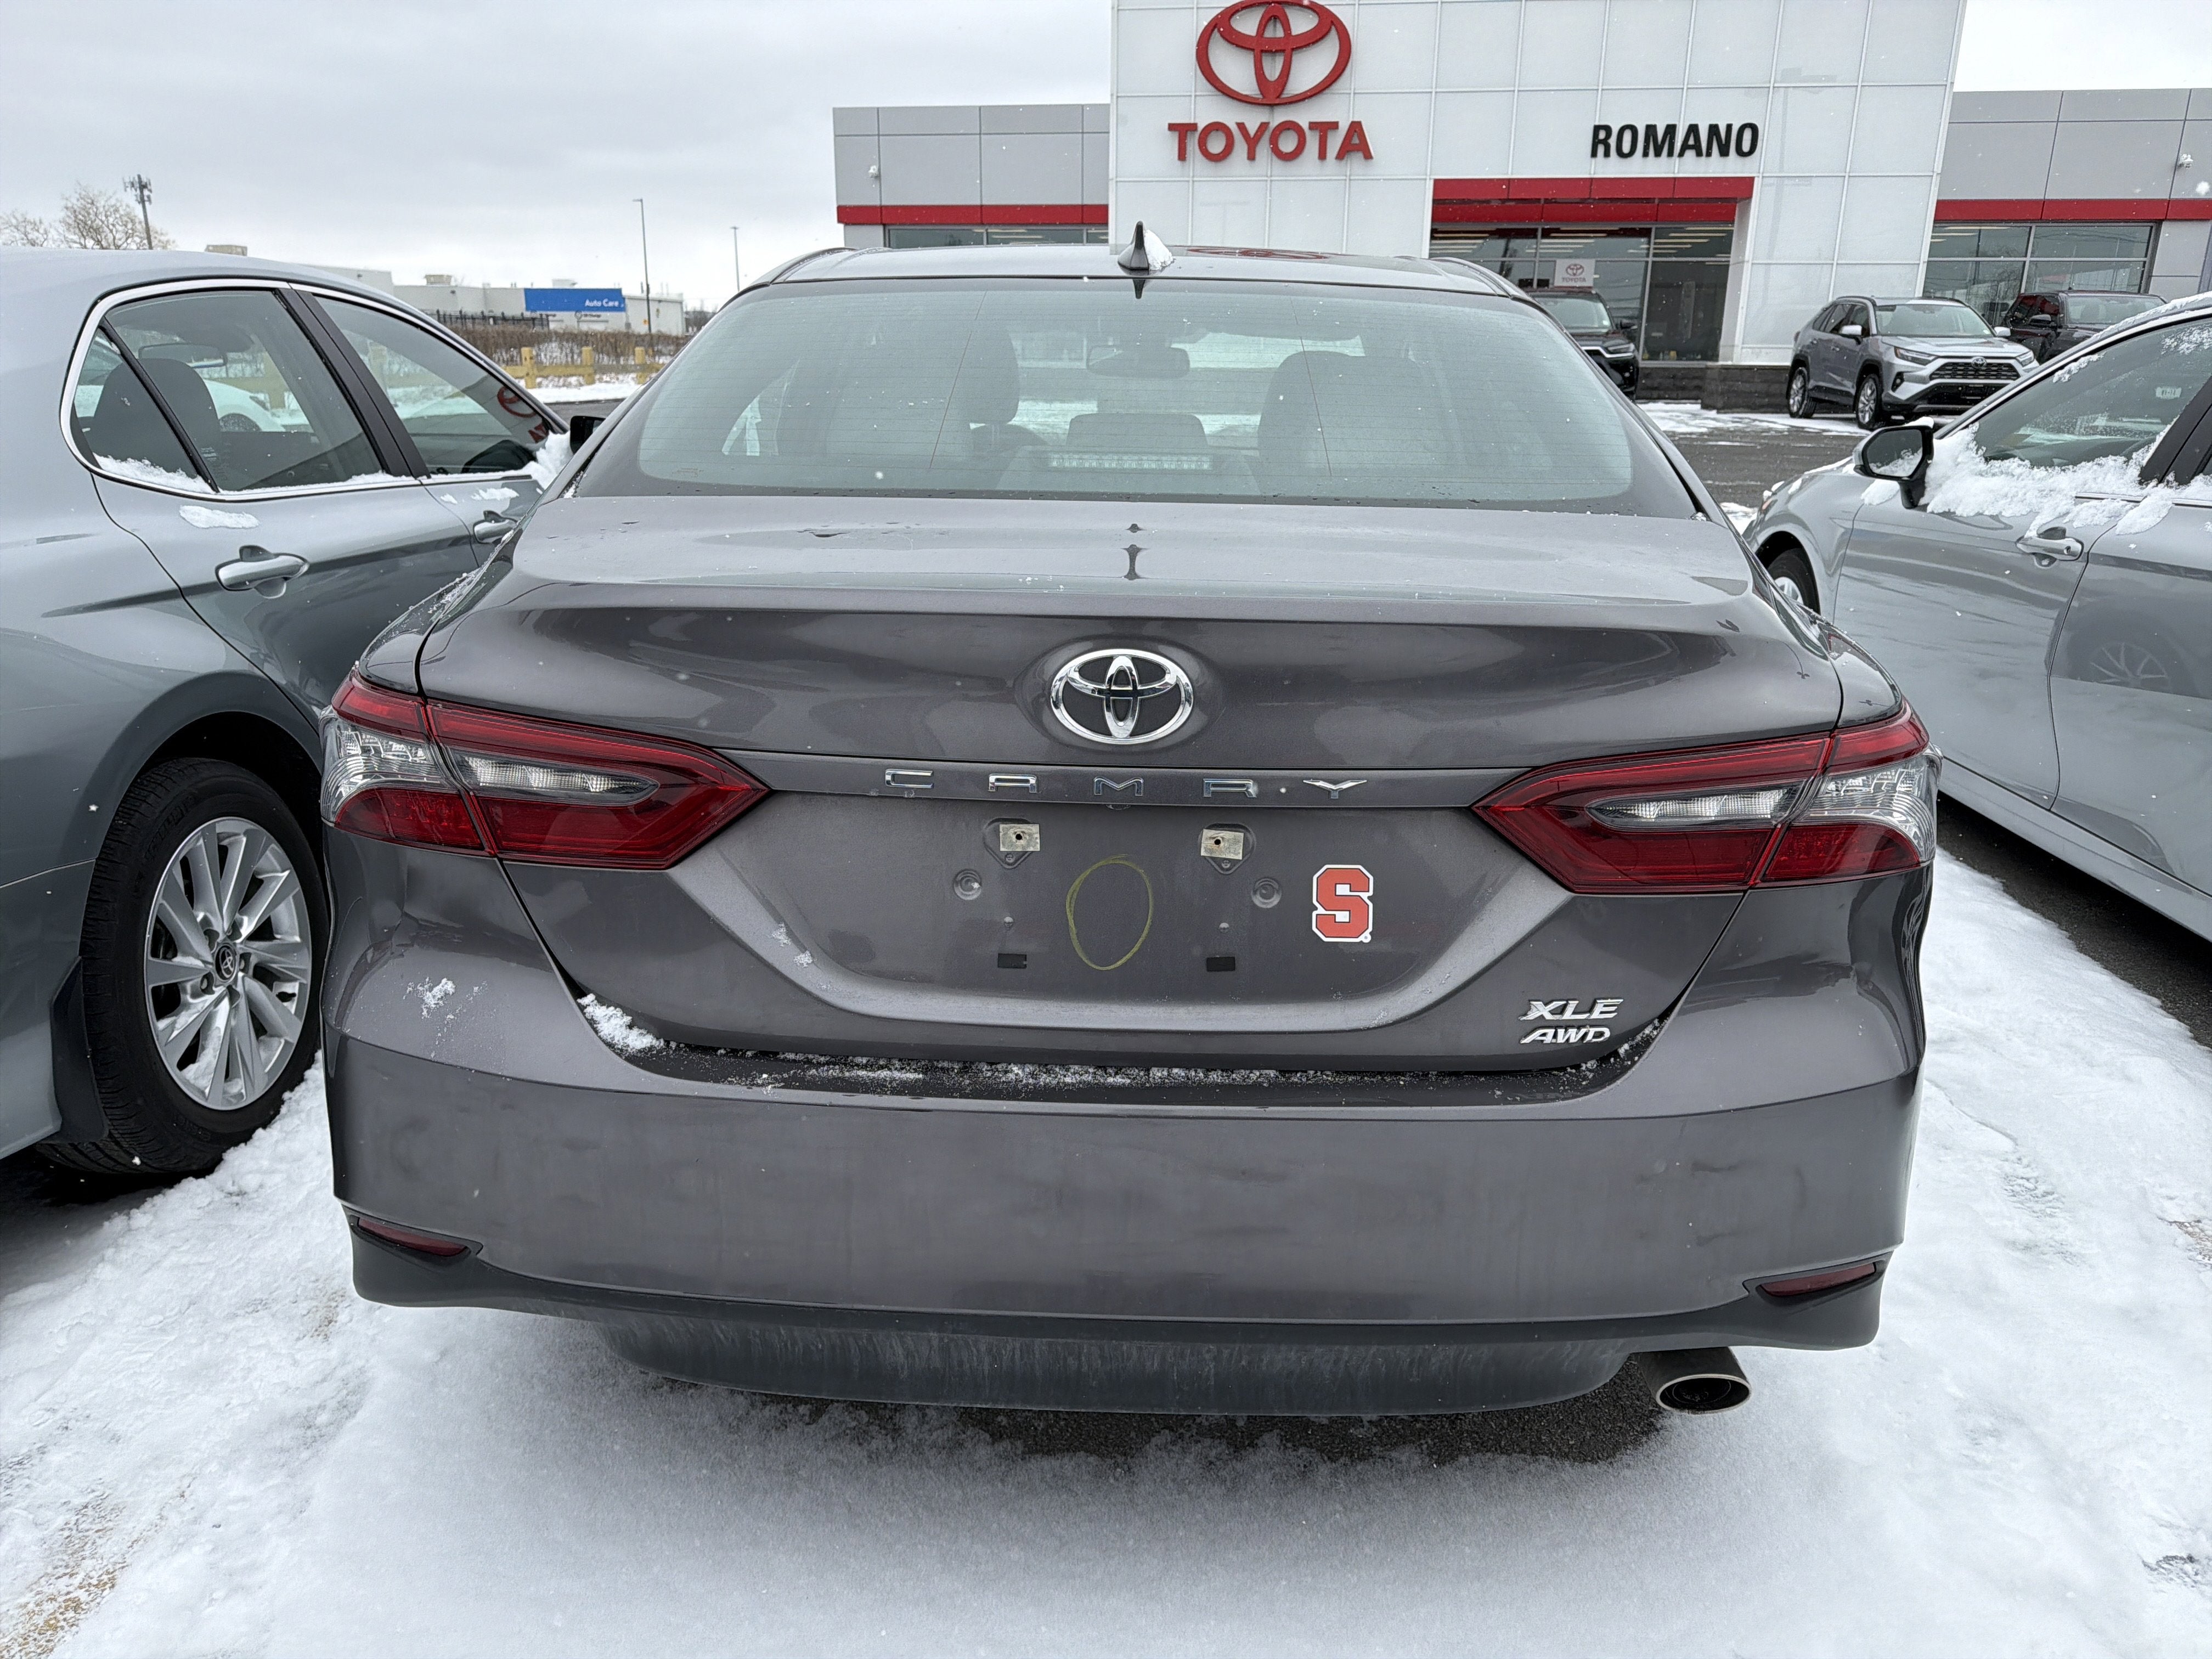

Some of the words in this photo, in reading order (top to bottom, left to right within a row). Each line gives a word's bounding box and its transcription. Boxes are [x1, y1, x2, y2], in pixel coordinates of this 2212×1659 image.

[1168, 120, 1373, 161] TOYOTA
[1590, 123, 1759, 159] ROMANO
[602, 298, 619, 307] Care
[885, 769, 1367, 799] CAMRY
[1316, 867, 1370, 939] S
[1518, 998, 1624, 1020] XLE
[1519, 1026, 1611, 1044] AWD
